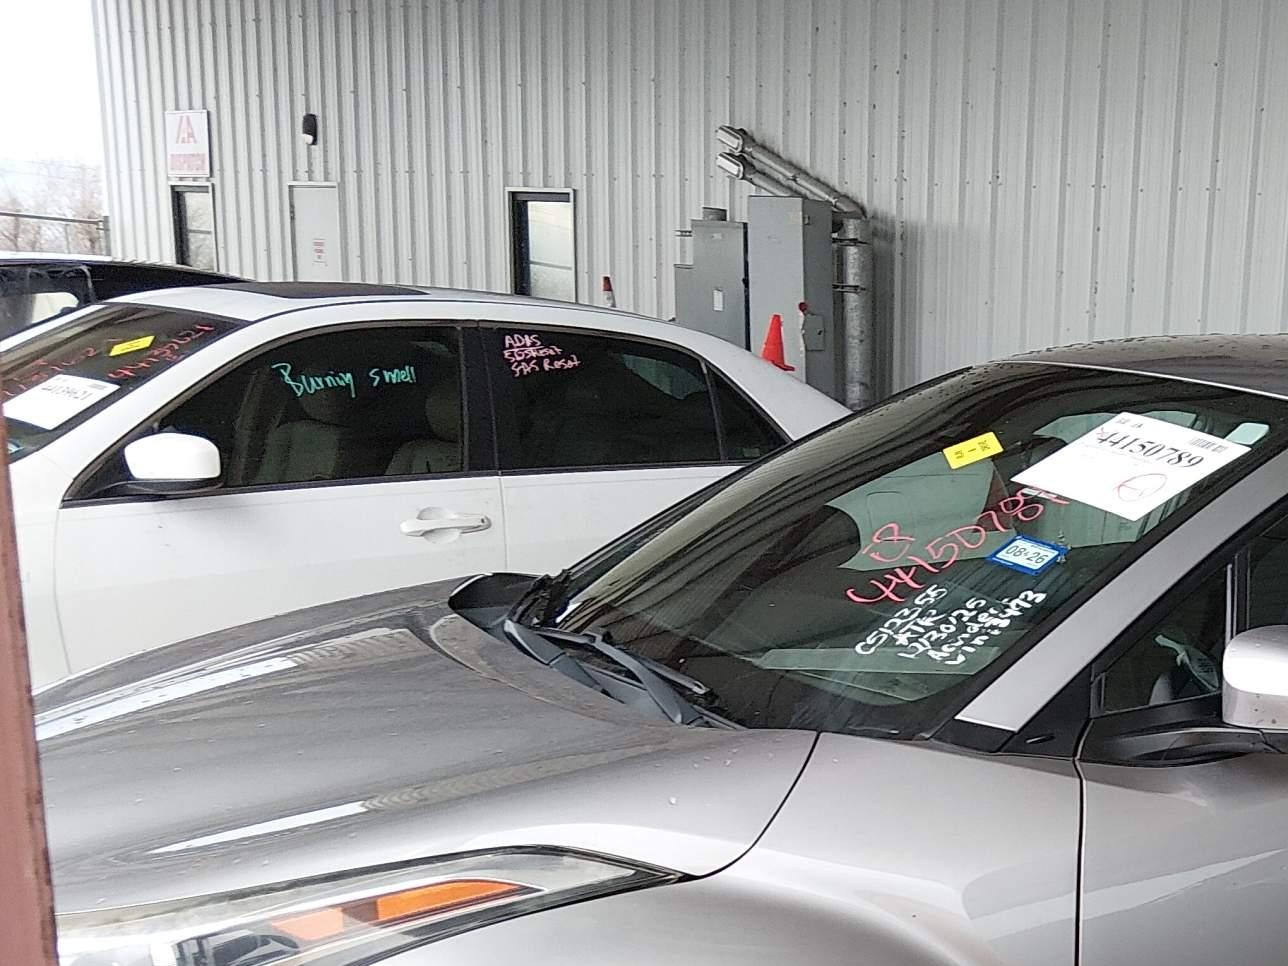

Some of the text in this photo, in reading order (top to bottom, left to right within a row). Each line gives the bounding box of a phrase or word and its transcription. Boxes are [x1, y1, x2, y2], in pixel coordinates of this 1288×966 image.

[1097, 431, 1204, 468] 44150789
[1005, 545, 1049, 564] 08 26
